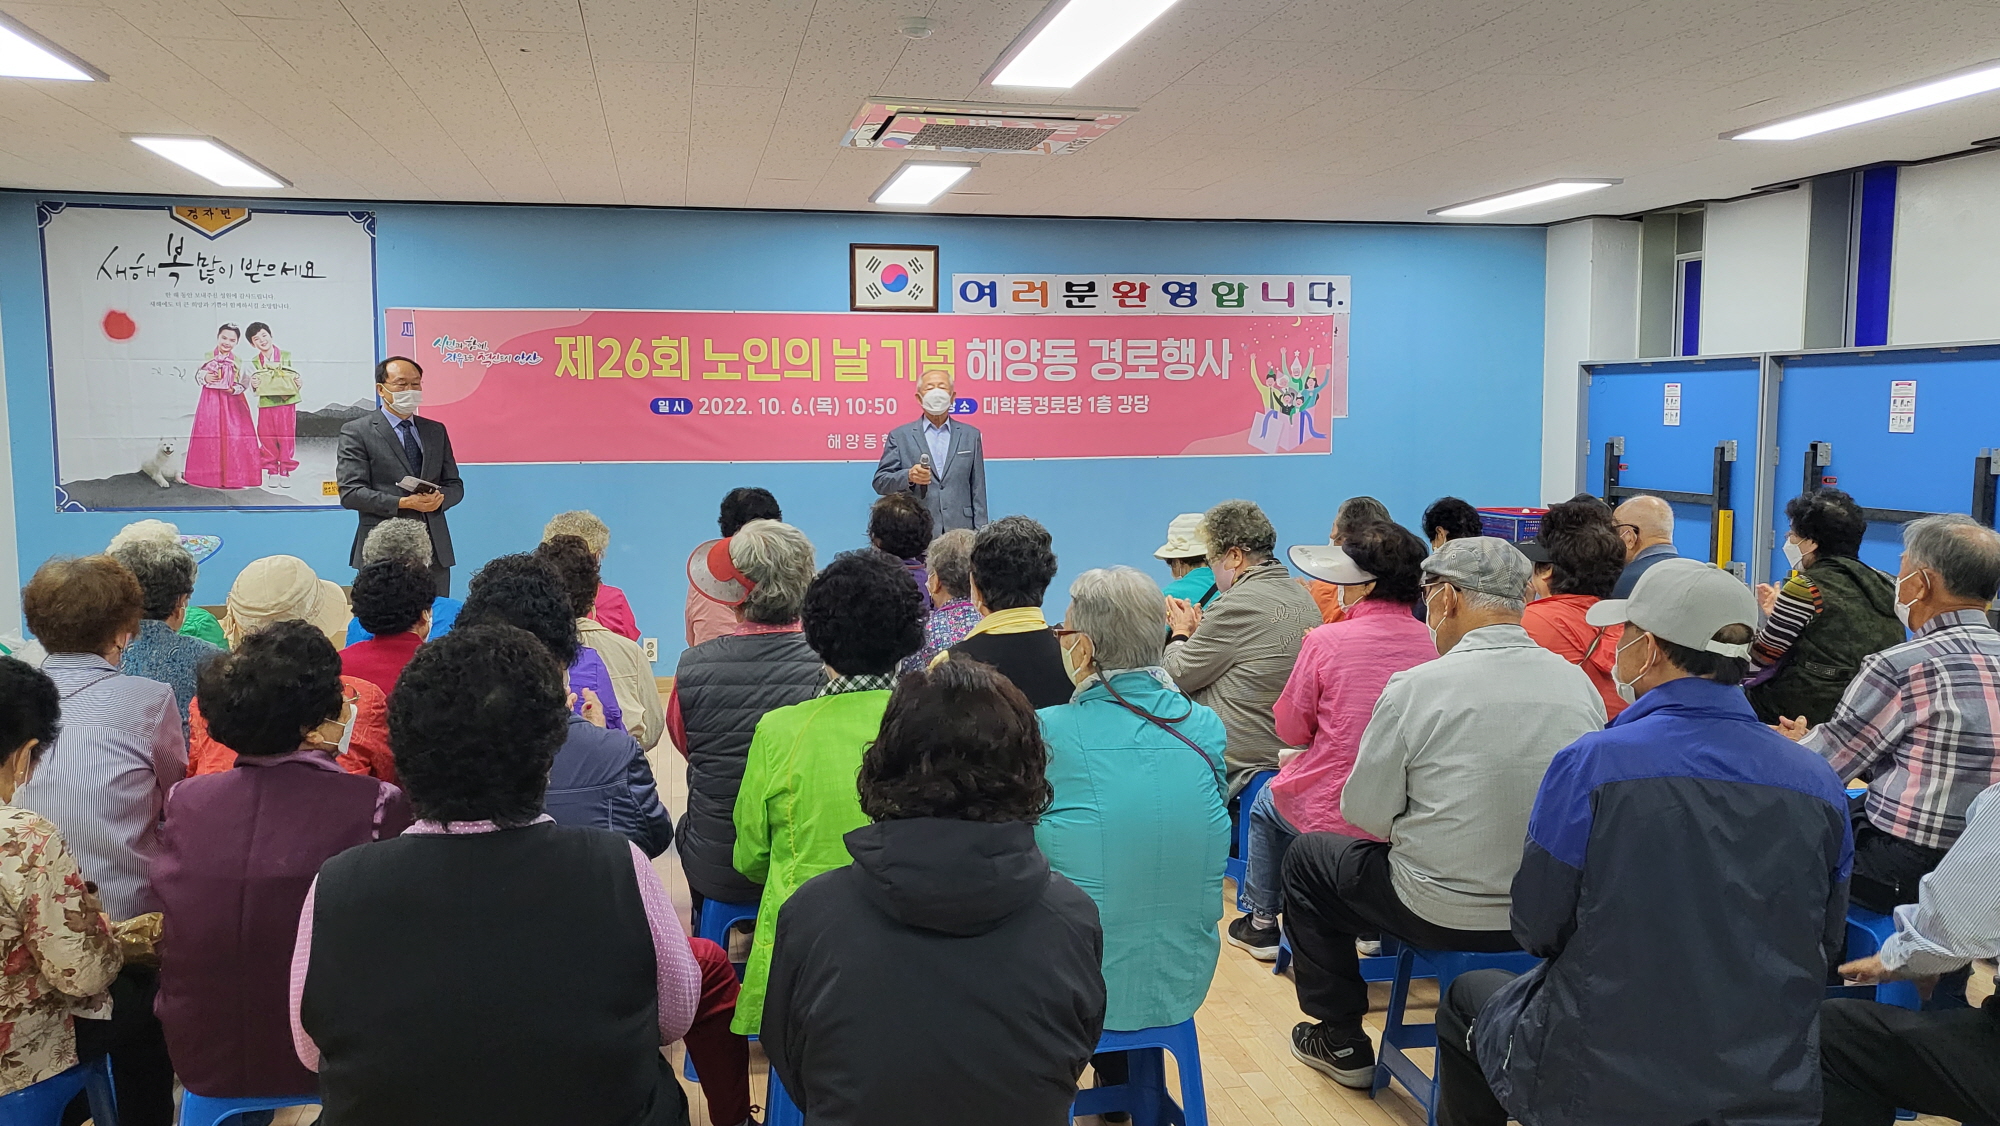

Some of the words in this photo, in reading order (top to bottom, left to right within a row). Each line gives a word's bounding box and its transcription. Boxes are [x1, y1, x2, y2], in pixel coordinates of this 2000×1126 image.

[97, 245, 156, 281] 새해
[157, 233, 195, 288] 복
[196, 252, 233, 285] 많이
[240, 257, 327, 283] 받으세요
[554, 335, 690, 381] 제26회
[702, 337, 821, 382] 노인의
[832, 338, 871, 382] 날
[966, 337, 1078, 382] 해양동
[1088, 337, 1233, 382] 경로행사
[698, 397, 753, 415] 2022.
[758, 397, 786, 415] 10.
[791, 396, 841, 416] 6.(목)
[845, 397, 897, 415] 10:50
[983, 395, 1083, 415] 대학동경로당
[1087, 394, 1113, 414] 1층
[1117, 394, 1150, 414] 강당
